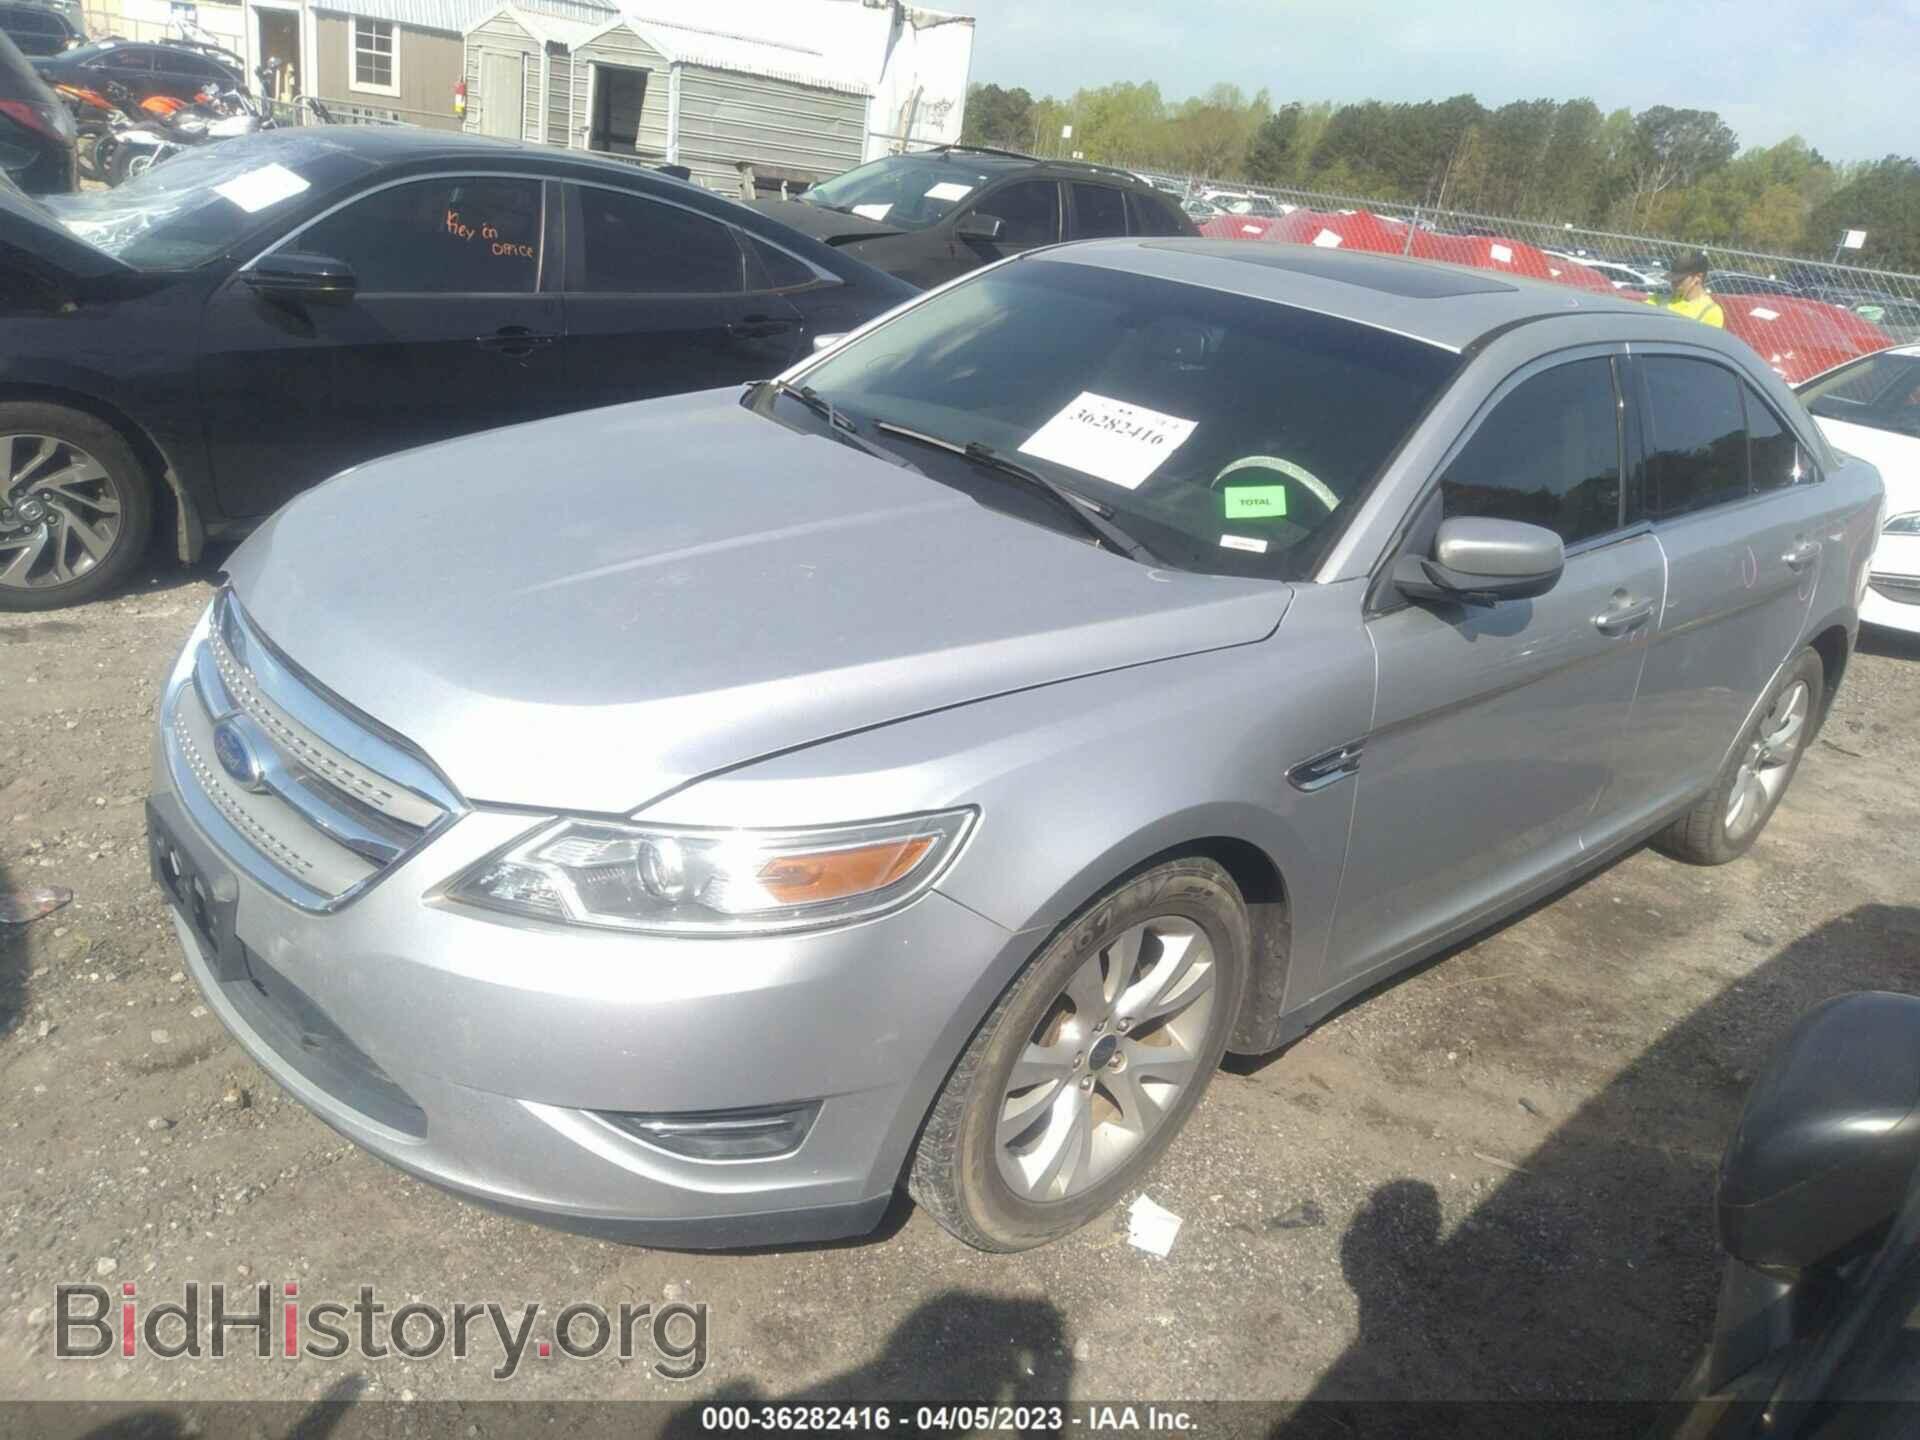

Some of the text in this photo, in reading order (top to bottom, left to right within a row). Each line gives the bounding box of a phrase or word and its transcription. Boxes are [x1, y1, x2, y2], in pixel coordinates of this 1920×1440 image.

[482, 222, 498, 239] in
[1070, 408, 1165, 446] 36282416
[1240, 498, 1272, 506] TOTAL
